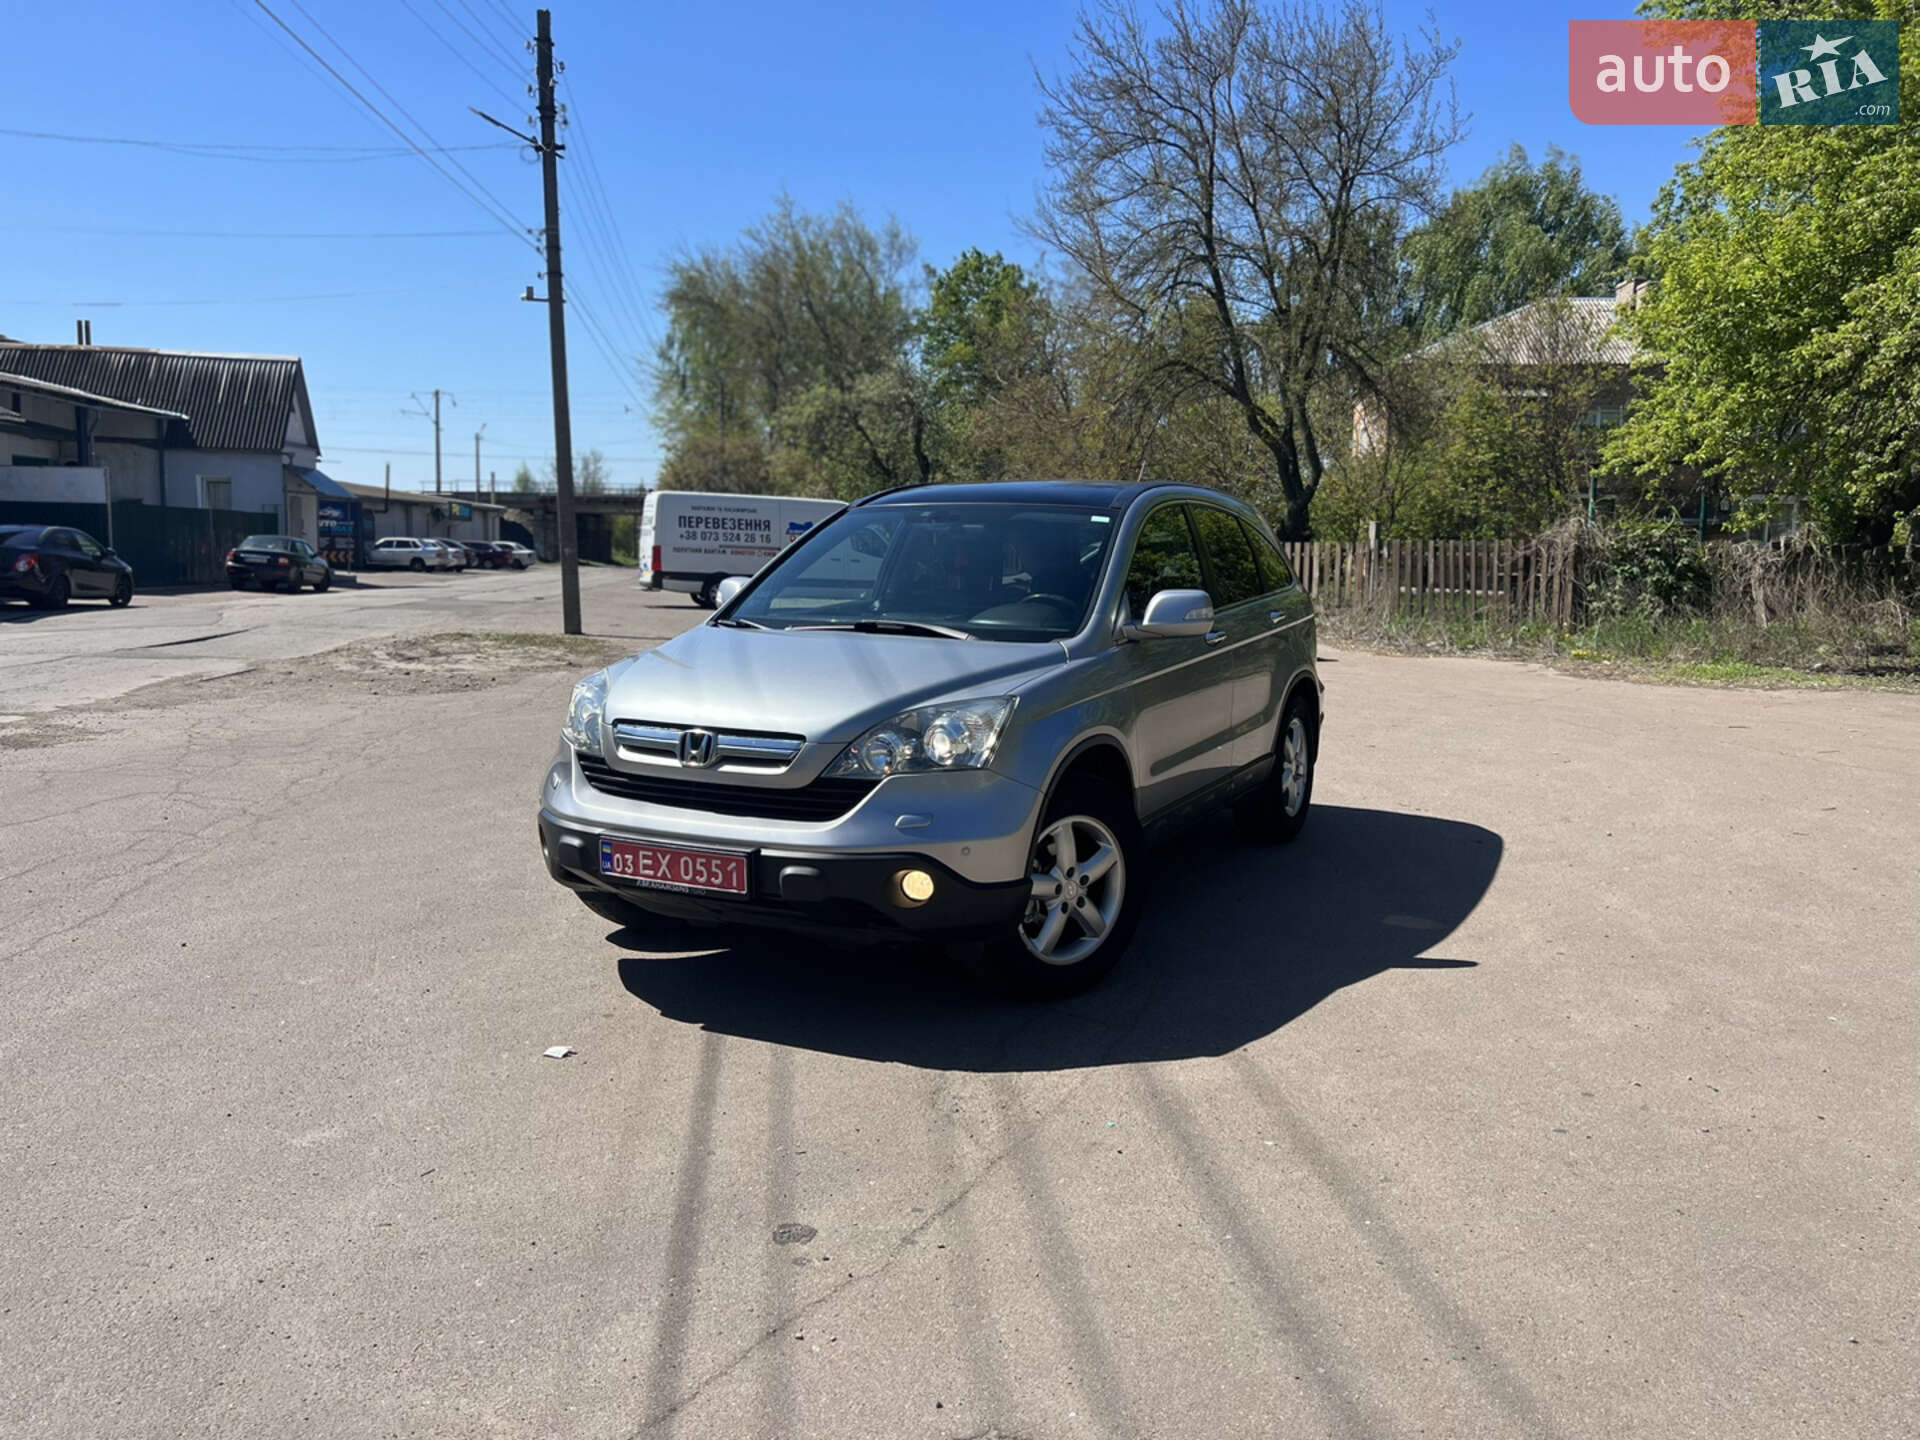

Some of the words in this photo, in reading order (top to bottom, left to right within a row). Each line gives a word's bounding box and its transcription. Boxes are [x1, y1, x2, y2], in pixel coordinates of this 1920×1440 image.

[678, 515, 771, 532] ПЕРЕВЕЗЕННЯ
[679, 530, 698, 541] +38
[700, 531, 720, 542] 073
[722, 532, 741, 542] 524
[613, 853, 634, 874] 03
[639, 850, 672, 879] EX
[680, 856, 738, 887] 0551
